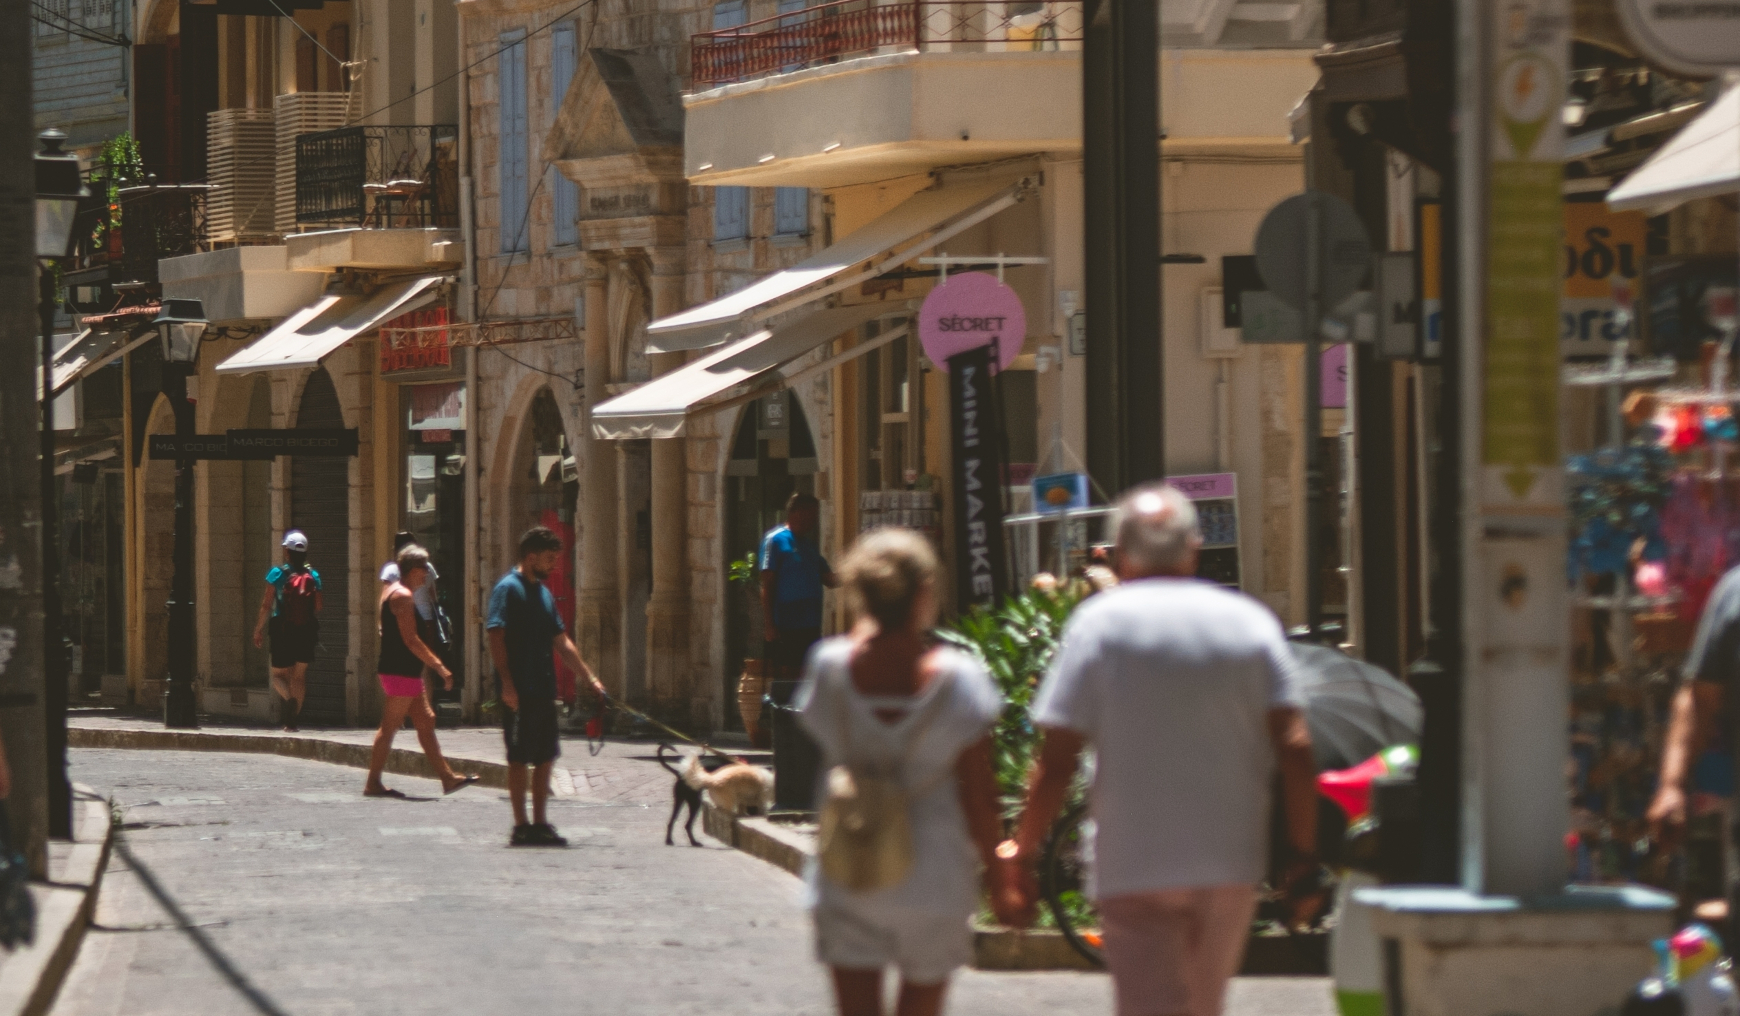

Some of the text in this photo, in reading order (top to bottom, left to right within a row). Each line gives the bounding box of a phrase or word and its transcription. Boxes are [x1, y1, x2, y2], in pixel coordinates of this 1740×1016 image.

[962, 366, 980, 447] MINI
[155, 442, 204, 452] MACO
[233, 437, 339, 447] MARCO BICEGO
